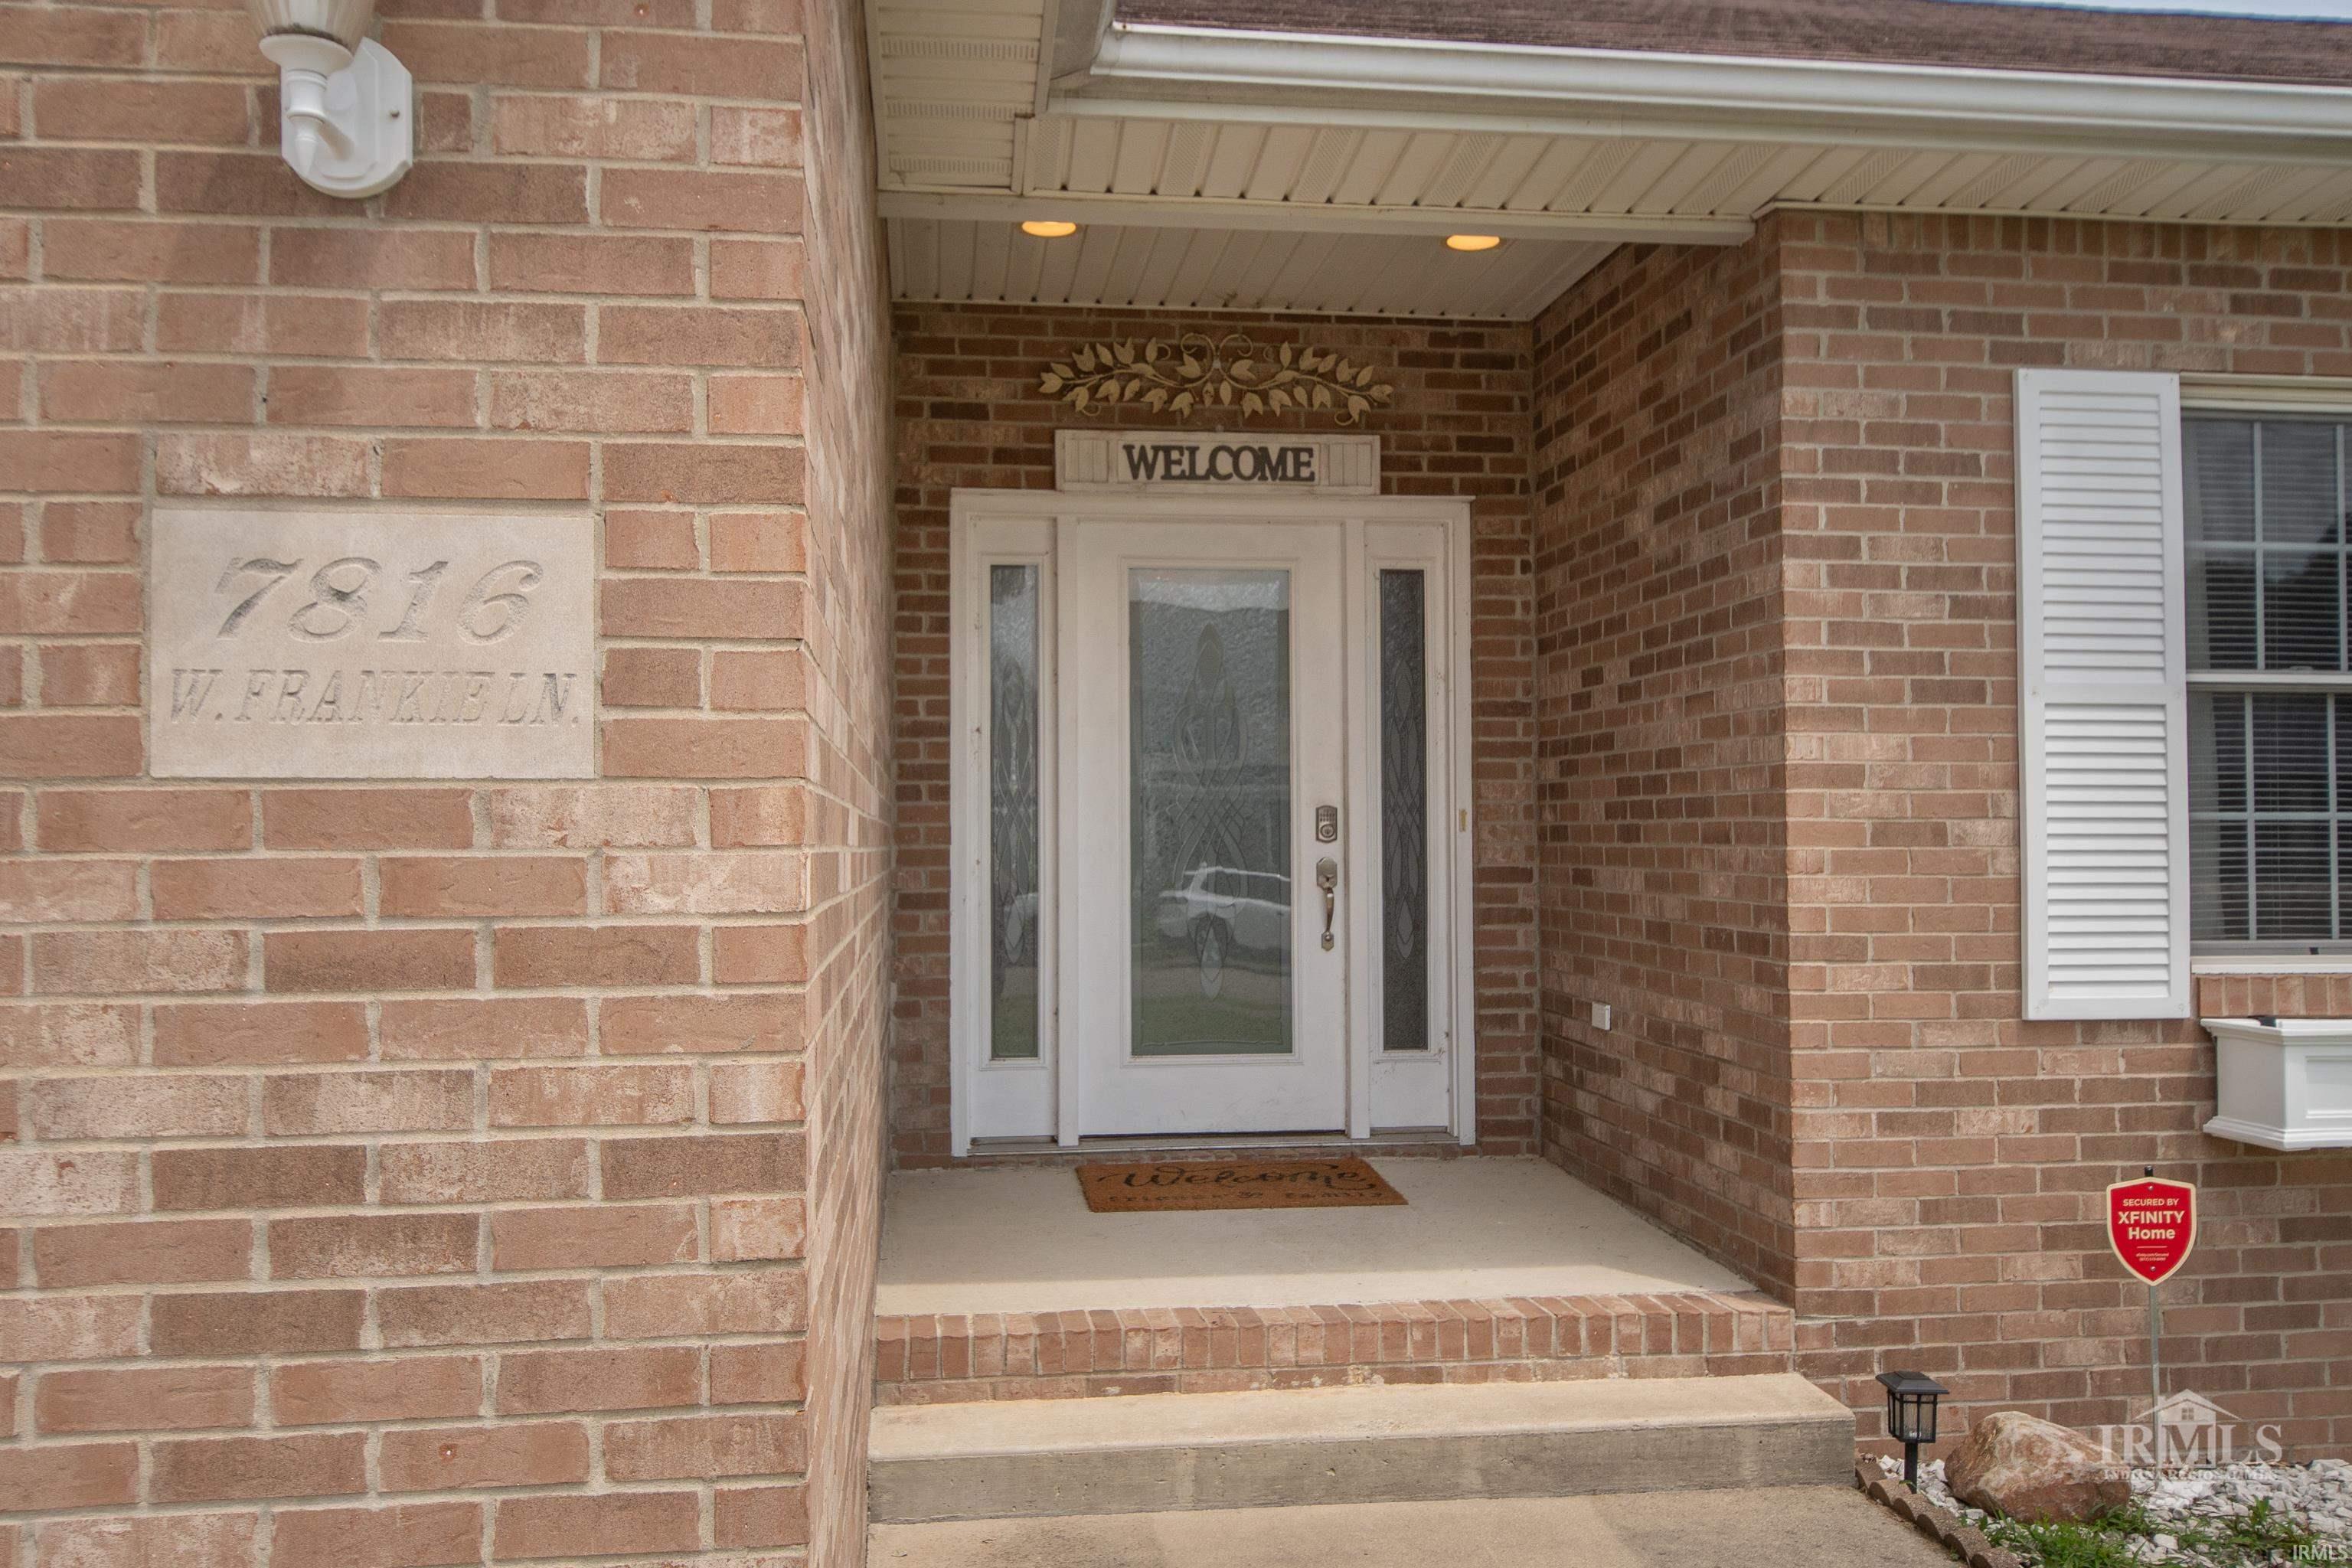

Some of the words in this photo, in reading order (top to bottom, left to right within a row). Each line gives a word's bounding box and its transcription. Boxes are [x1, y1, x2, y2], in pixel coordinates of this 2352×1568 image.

[1123, 444, 1315, 482] WELCOME
[214, 557, 544, 645] 7816
[234, 669, 495, 726] FRANKIE
[1098, 1162, 1377, 1191] Welcome
[2118, 1210, 2185, 1224] XFINITY
[2123, 1198, 2164, 1207] SECURED
[2128, 1227, 2175, 1240] Home
